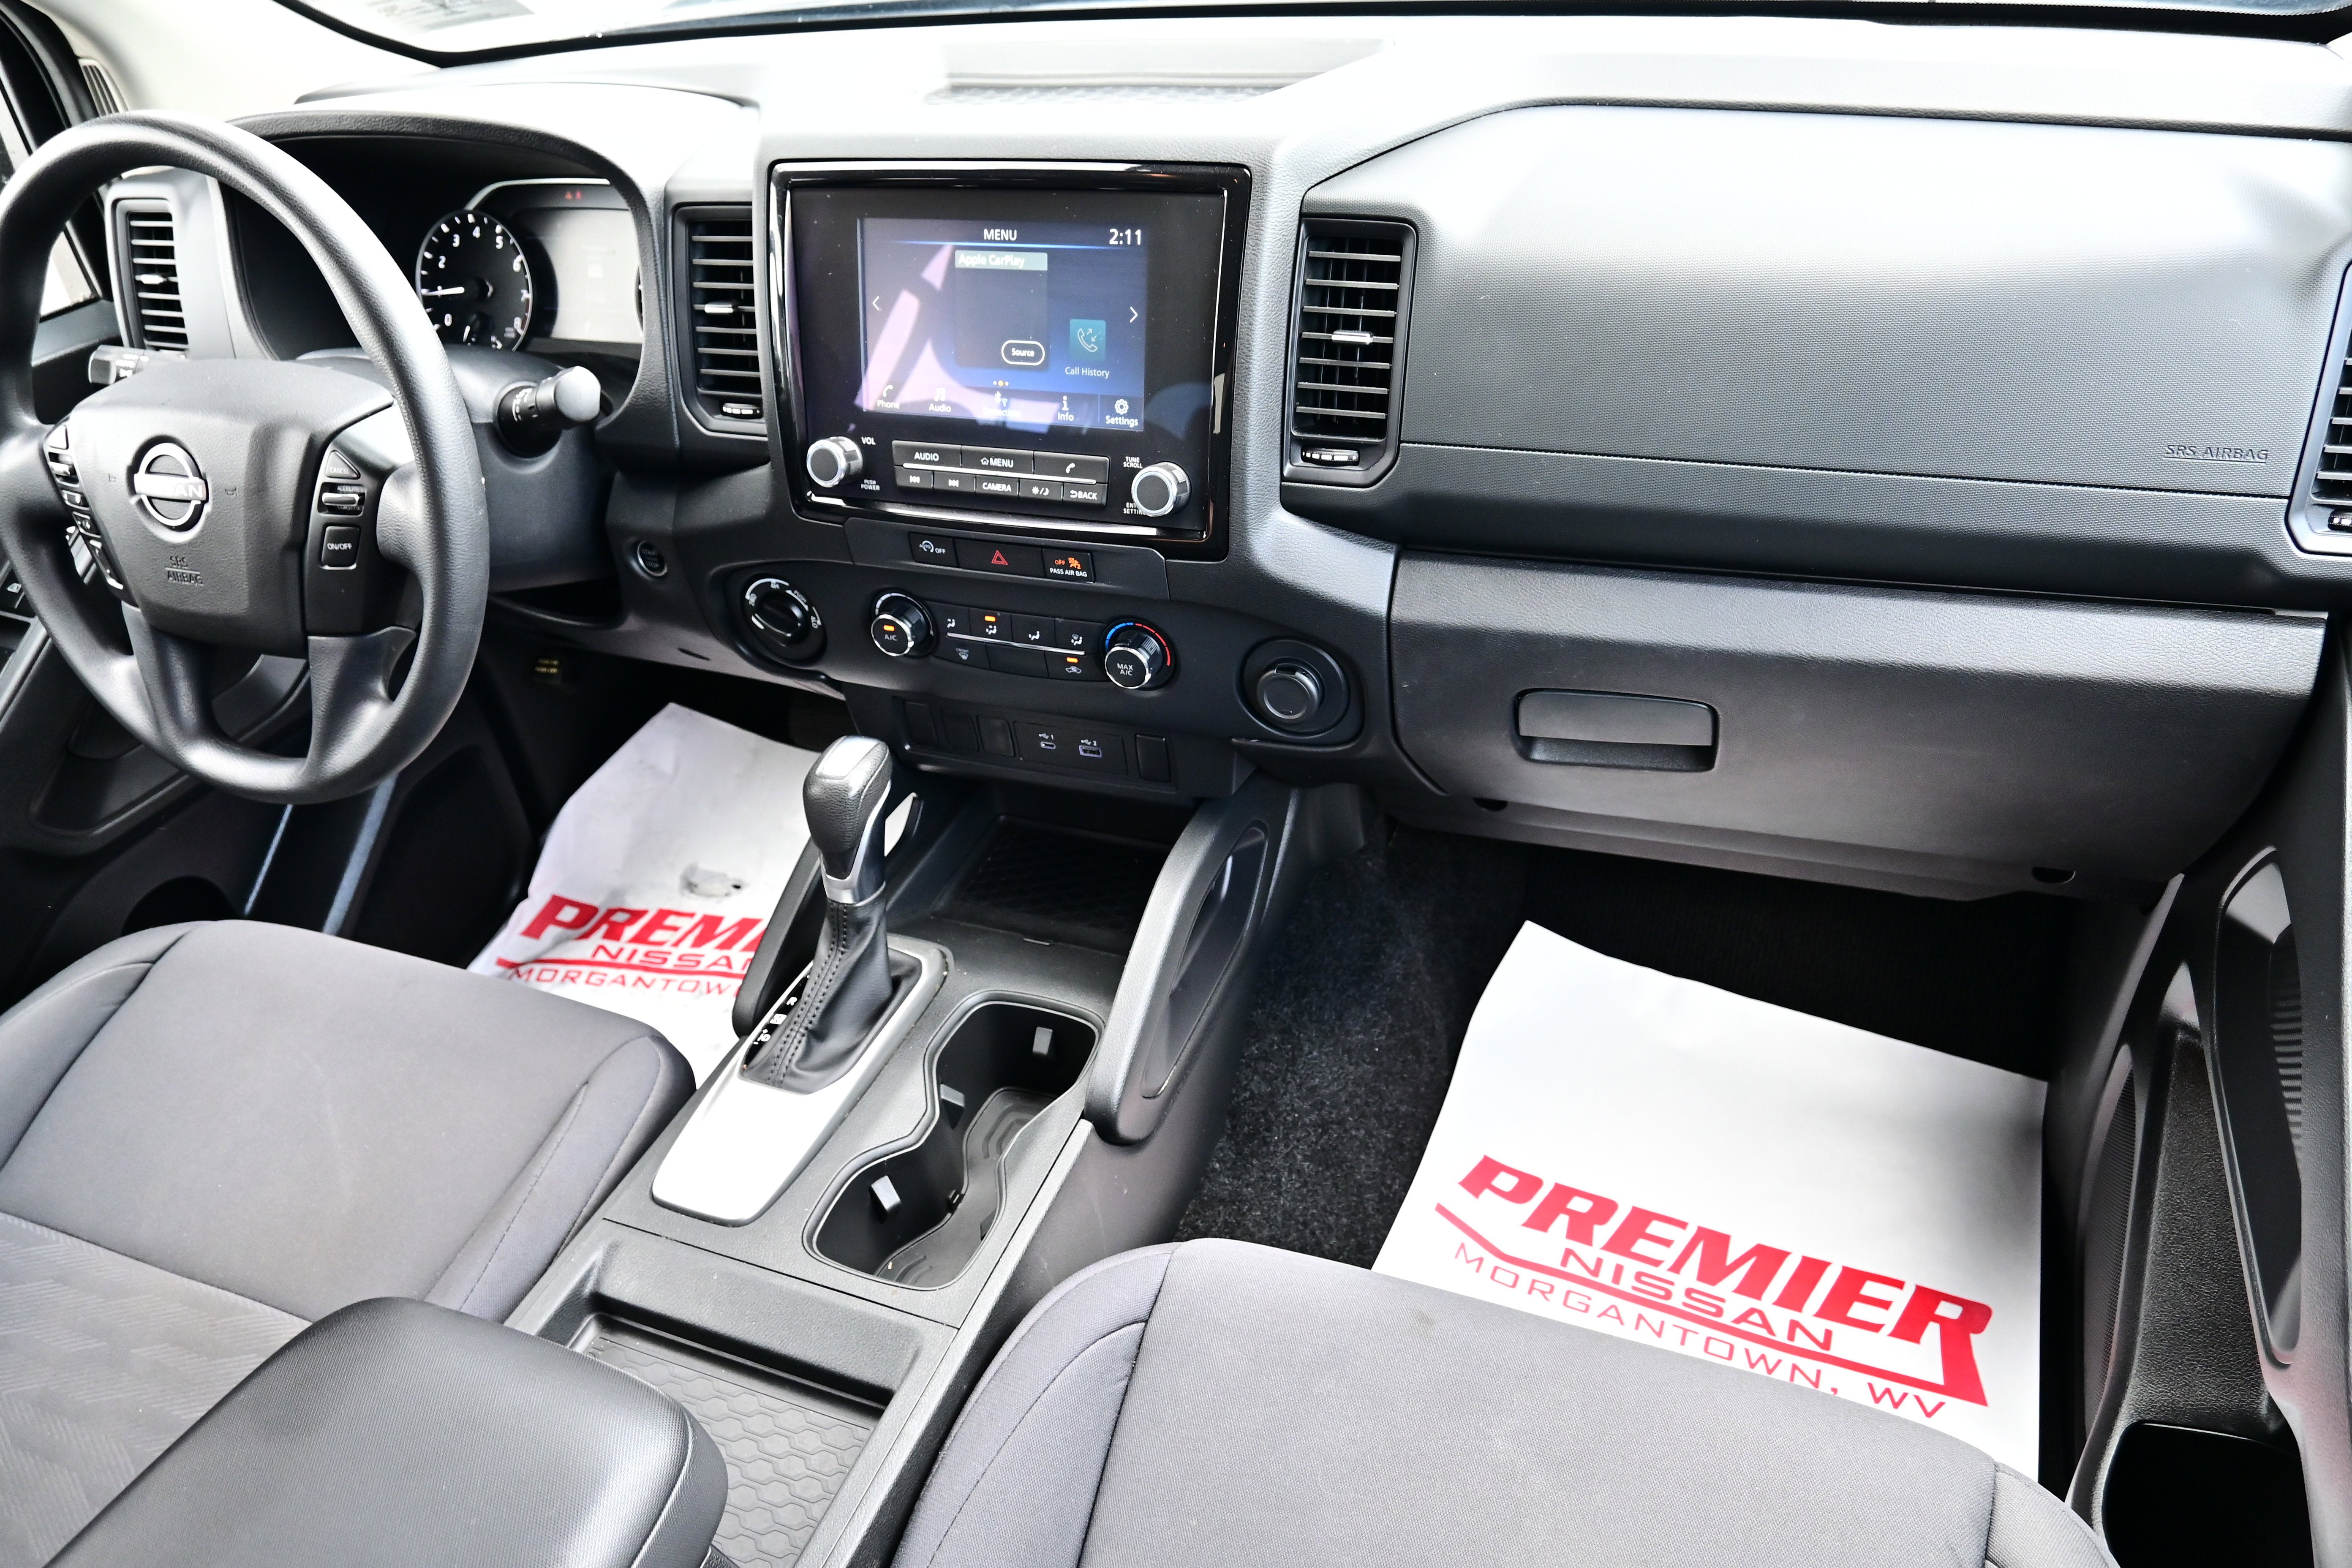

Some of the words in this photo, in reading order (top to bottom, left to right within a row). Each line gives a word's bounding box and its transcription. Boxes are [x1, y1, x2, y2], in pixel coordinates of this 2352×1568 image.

[473, 226, 480, 238] 4
[984, 229, 1017, 241] MENU
[1109, 229, 1141, 245] 2:11
[452, 234, 460, 247] 3
[495, 236, 503, 249] 5
[438, 256, 446, 269] 2
[958, 253, 986, 267] Apple
[989, 254, 1025, 268] CarPlay
[444, 313, 452, 327] 0
[1012, 348, 1034, 357] Source
[1065, 366, 1079, 375] Call
[1081, 368, 1110, 379] History
[877, 400, 900, 409] Phone
[929, 403, 951, 413] Audio
[1057, 412, 1074, 421] Info
[1105, 415, 1138, 427] Settings
[861, 436, 876, 445] VOL
[914, 452, 939, 461] AUDIO
[2165, 444, 2196, 456] SRS
[2202, 446, 2269, 461] AIRBAG
[989, 457, 1014, 468] MENU
[982, 482, 1012, 492] CAMERA
[1078, 490, 1097, 500] BACK
[1050, 567, 1064, 575] PASS
[1117, 663, 1133, 671] MAX
[507, 965, 742, 998] MORGANTOW
[787, 996, 797, 1006] R
[1458, 1154, 1993, 1407] PREMIER
[1560, 1247, 1834, 1353] NISSAN
[1454, 1241, 1840, 1396] MORGANTOWN,
[1866, 1382, 1946, 1419] WV
